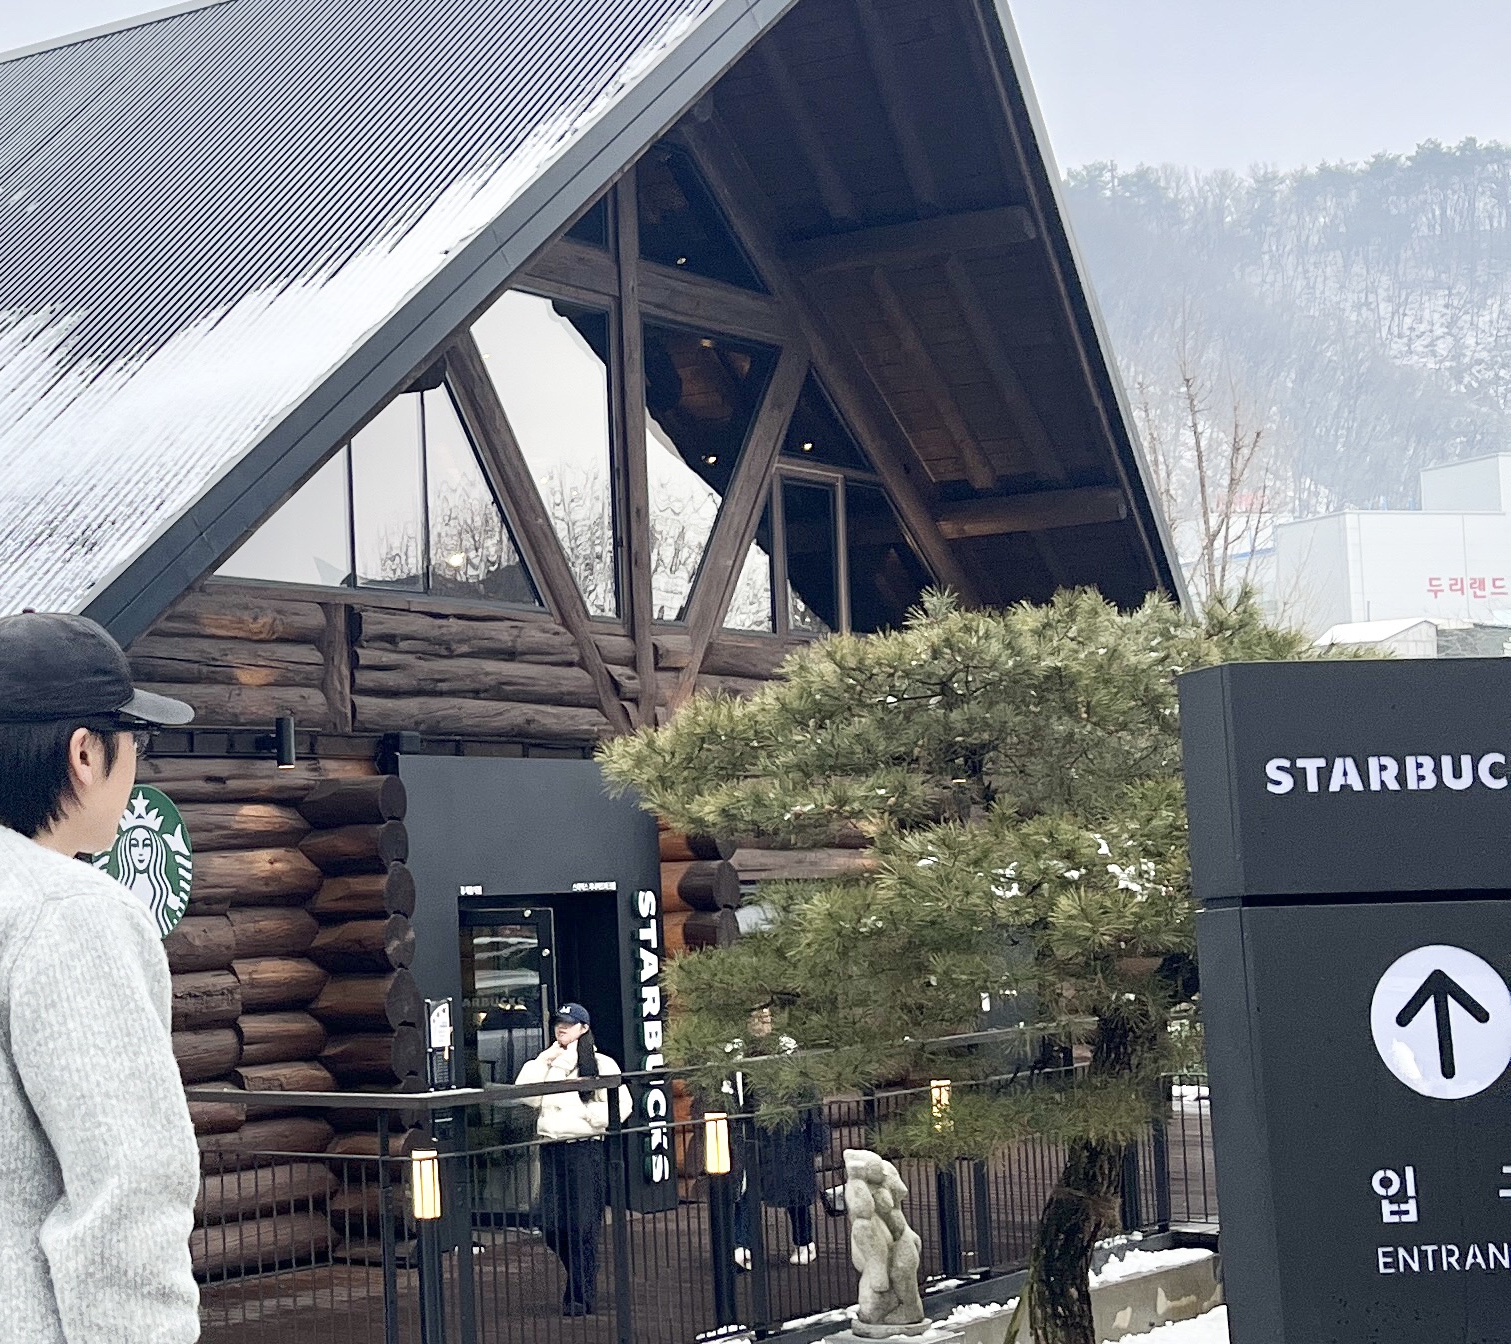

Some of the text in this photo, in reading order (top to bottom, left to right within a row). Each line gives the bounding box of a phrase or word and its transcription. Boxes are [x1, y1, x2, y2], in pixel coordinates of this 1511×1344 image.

[1427, 577, 1509, 599] 두리랜드
[1265, 752, 1509, 795] STARBUC
[638, 890, 670, 1183] STARBUCKS
[1377, 1242, 1510, 1274] ENTRAN
